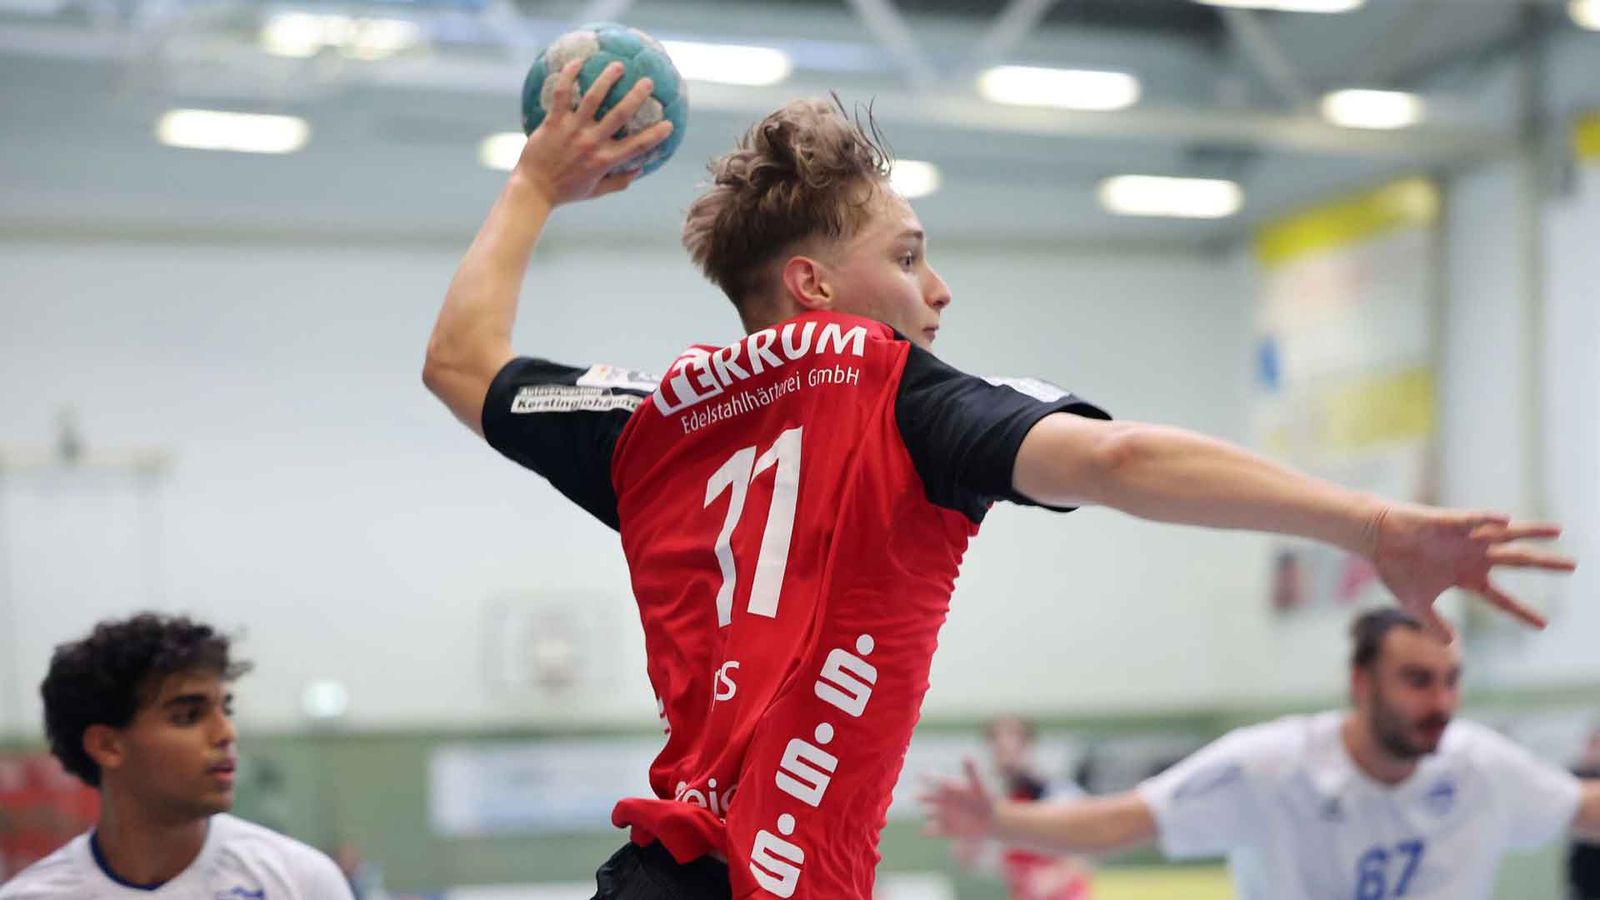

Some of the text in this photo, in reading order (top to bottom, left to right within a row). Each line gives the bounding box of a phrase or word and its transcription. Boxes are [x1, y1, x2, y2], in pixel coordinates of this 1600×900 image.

[653, 321, 868, 417] FERRUM
[681, 364, 860, 434] Edelstahlhärterei GmbH
[704, 426, 803, 628] 11
[1354, 838, 1426, 900] 67
